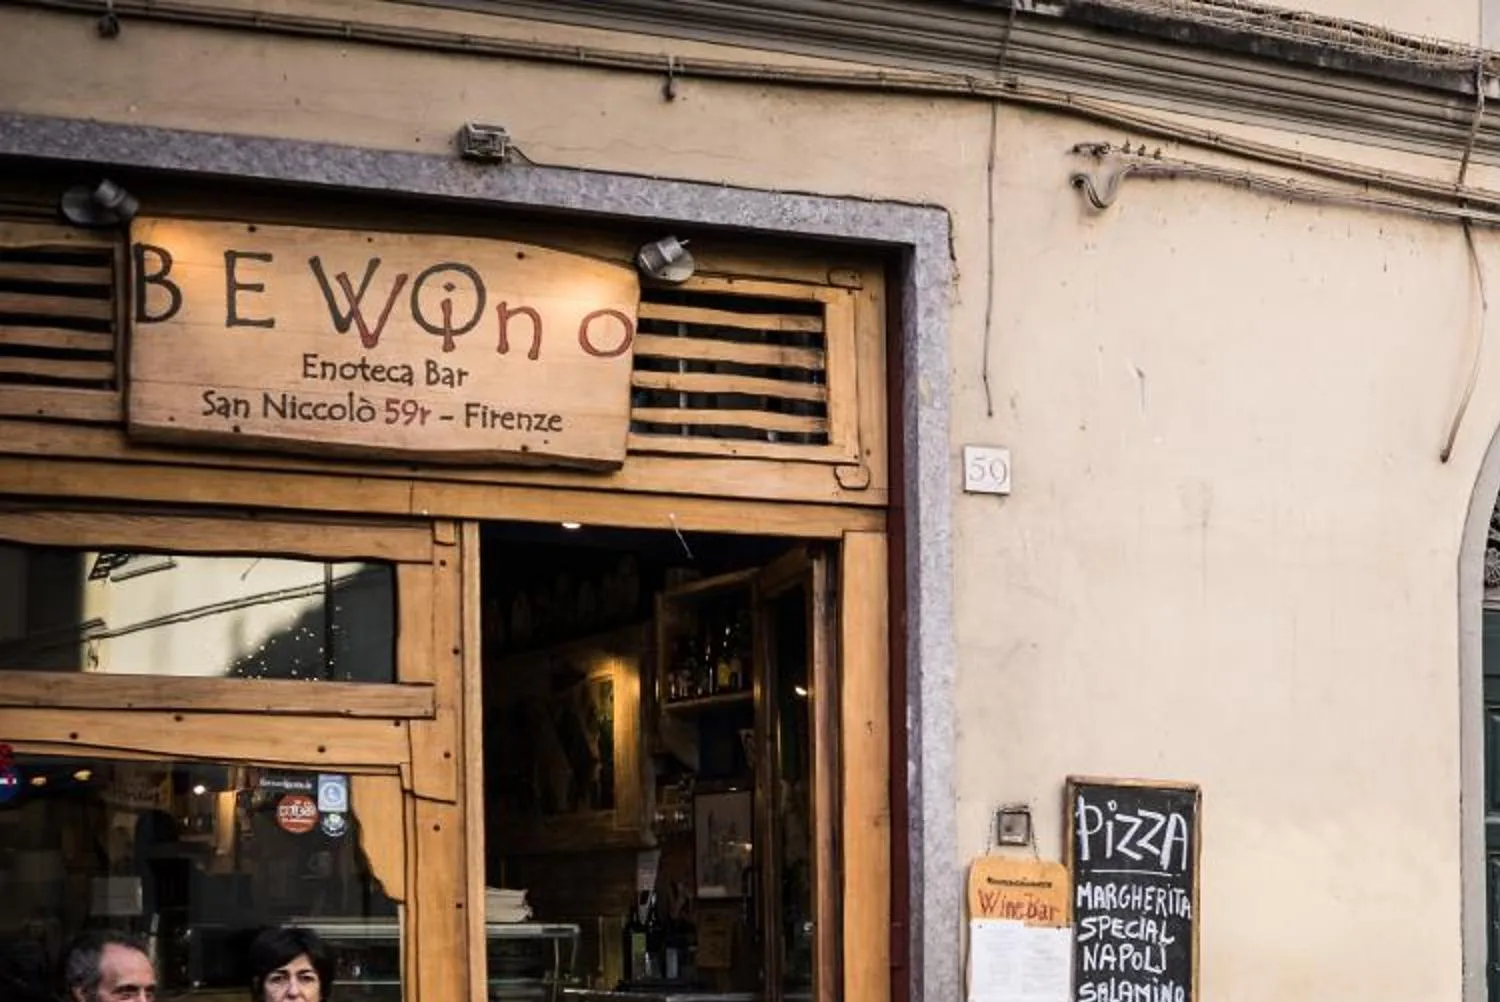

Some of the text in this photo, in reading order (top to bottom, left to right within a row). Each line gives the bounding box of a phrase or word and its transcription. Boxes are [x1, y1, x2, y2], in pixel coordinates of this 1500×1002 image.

[302, 353, 469, 388] Enoteca Bar
[202, 389, 250, 418] San
[262, 391, 376, 422] Niccolò
[384, 398, 432, 425] 59r
[464, 402, 563, 432] Firenze
